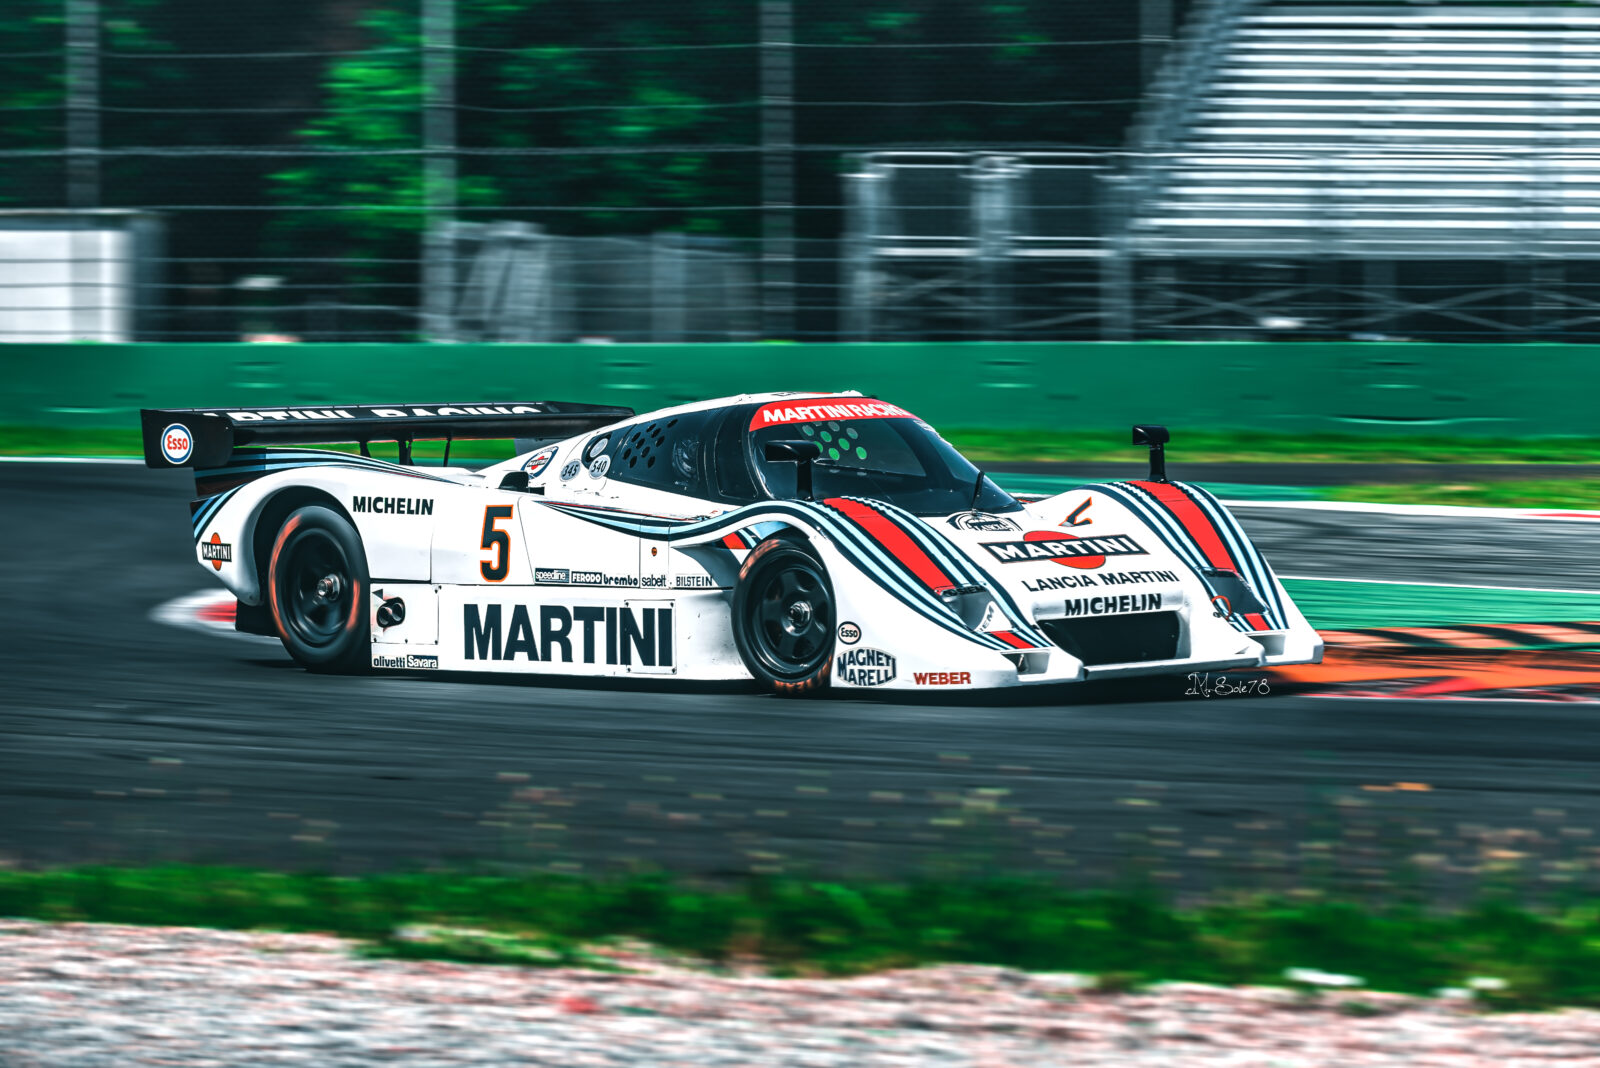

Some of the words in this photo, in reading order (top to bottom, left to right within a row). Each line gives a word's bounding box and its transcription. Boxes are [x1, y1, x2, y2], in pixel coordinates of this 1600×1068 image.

[763, 404, 856, 422] MARTINI
[847, 403, 911, 417] RACING
[167, 435, 189, 450] Esso
[562, 464, 579, 477] 345
[590, 460, 608, 473] 540
[352, 496, 434, 515] MICHELIN
[480, 504, 514, 582] 5
[988, 536, 1141, 561] MARTINI
[202, 544, 231, 560] MARTINI
[572, 572, 602, 583] FERODO
[603, 575, 638, 586] brembo
[641, 574, 667, 587] sabelt
[675, 576, 713, 587] BILSTEIN
[1021, 575, 1099, 592] LANCIA
[1097, 570, 1181, 587] MARTINI
[1065, 593, 1162, 616] MICHELIN
[463, 603, 673, 667] MARTINI
[840, 627, 858, 638] Esso
[373, 655, 405, 668] olivetti
[407, 655, 438, 668] Savara
[837, 649, 897, 671] MAGNETI
[837, 666, 897, 686] MARELLI
[913, 672, 972, 685] WEBER
